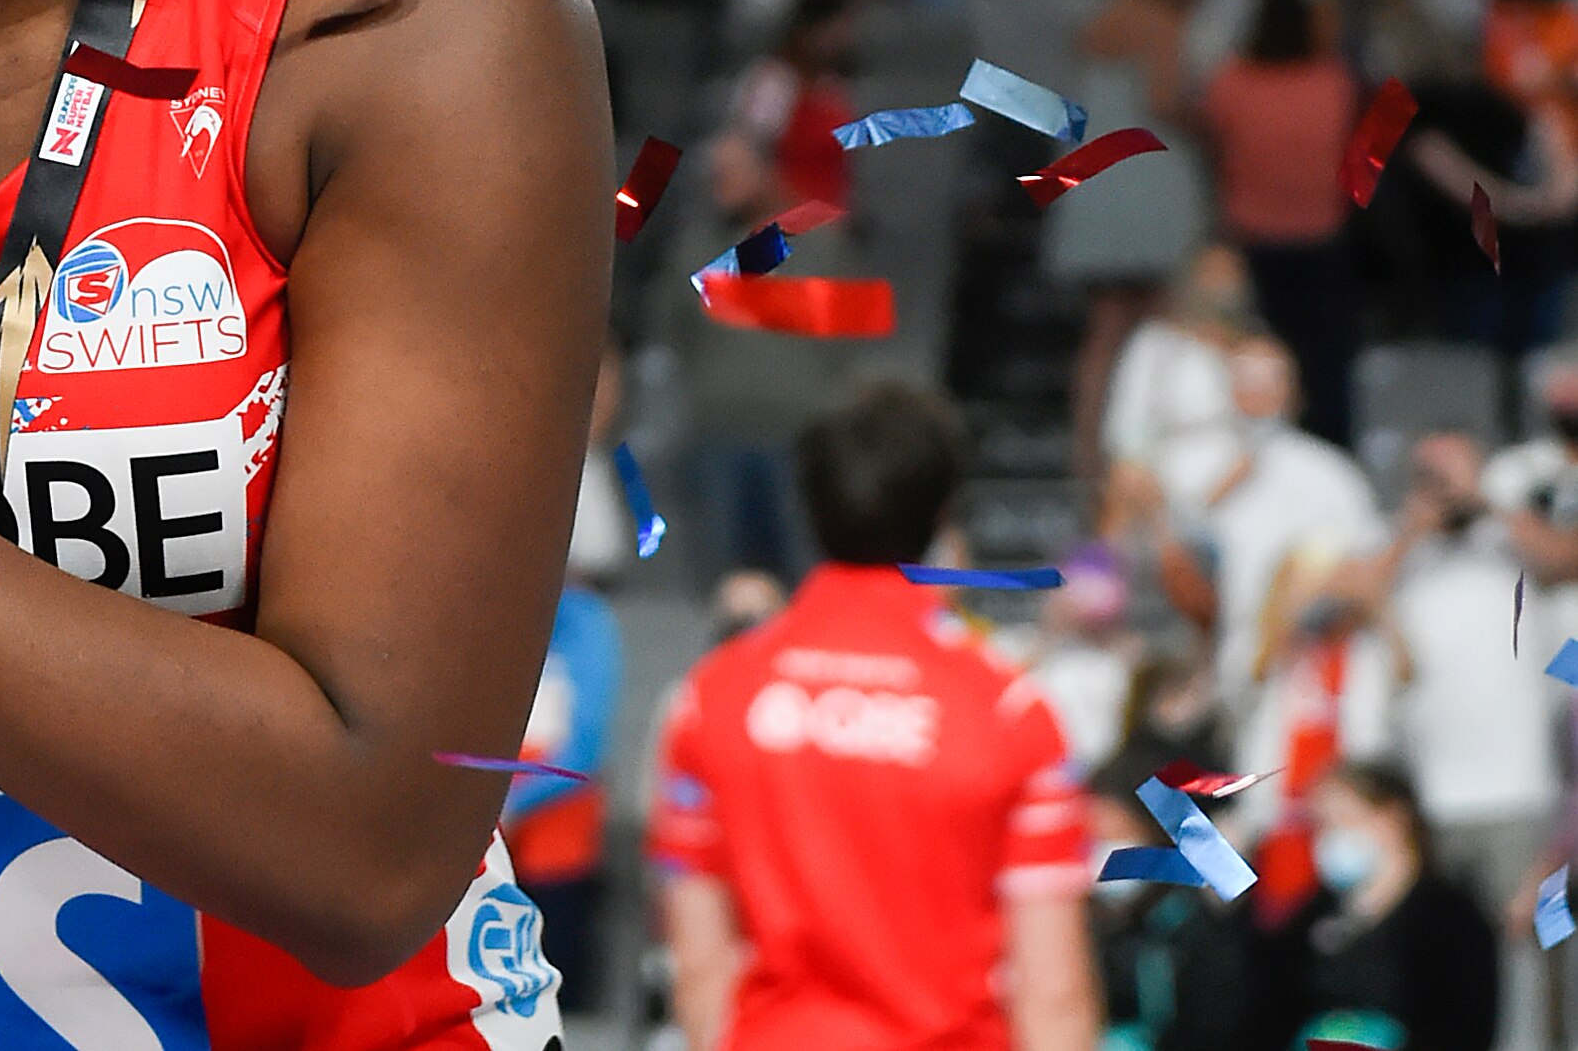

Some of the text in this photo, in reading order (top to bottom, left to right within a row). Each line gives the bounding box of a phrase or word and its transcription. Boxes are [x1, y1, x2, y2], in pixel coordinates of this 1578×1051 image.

[66, 89, 84, 126] SUPER
[75, 85, 96, 128] NETBAL
[131, 281, 224, 318] nsw
[42, 315, 245, 370] SWIFTS
[0, 449, 224, 598] BE
